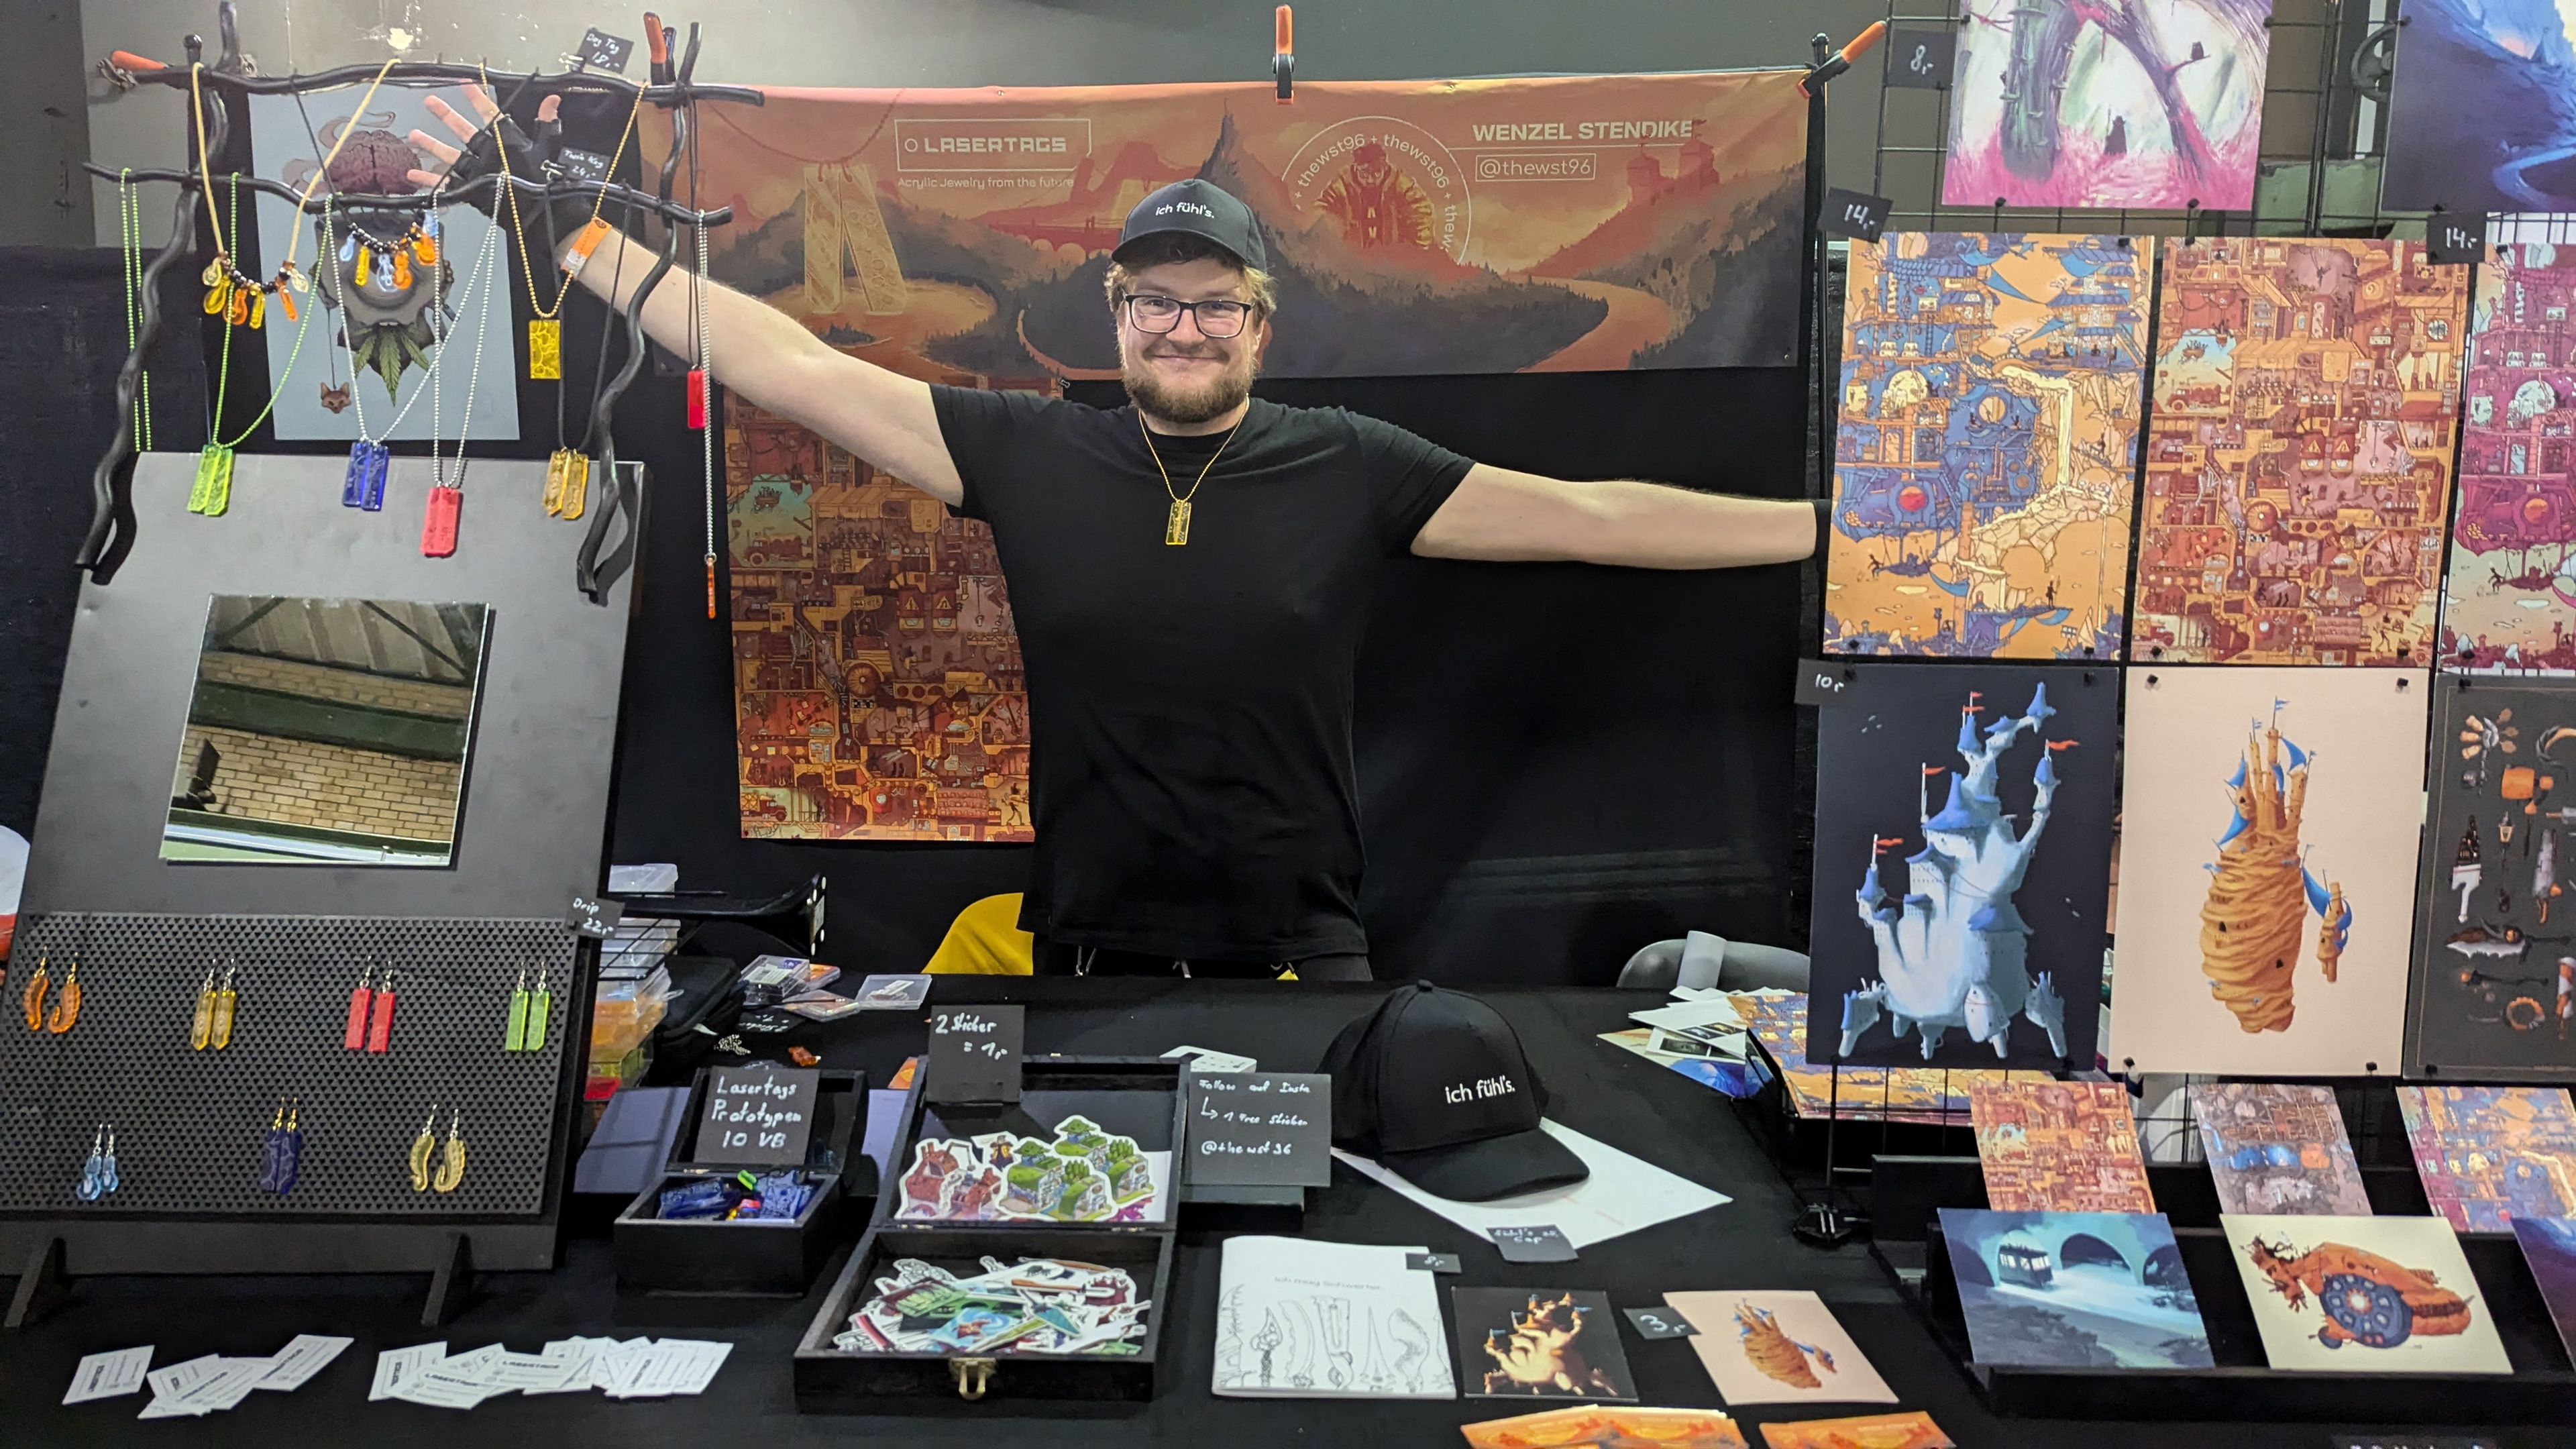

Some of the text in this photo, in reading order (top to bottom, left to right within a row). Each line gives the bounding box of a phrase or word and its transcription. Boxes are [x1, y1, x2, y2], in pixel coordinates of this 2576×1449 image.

[1472, 120, 1693, 142] WENZEL STENDIKE
[924, 137, 1067, 153] LASERTAGS
[1297, 133, 1366, 187] thewst96
[1383, 133, 1450, 189] thewst96
[1479, 158, 1591, 178] @thewst96
[898, 177, 1075, 190] Acrylic Jewelry from the future
[1155, 204, 1173, 216] ich
[572, 897, 600, 916] Drip
[935, 1012, 997, 1034] 2 Sticker
[716, 1074, 798, 1100] Lasertags
[1199, 1079, 1311, 1094] Follow auf Insta
[1445, 1074, 1516, 1104] ich fühl's.
[711, 1098, 802, 1129] Prototypen
[1222, 1111, 1234, 1122] 1
[722, 1130, 748, 1148] 10
